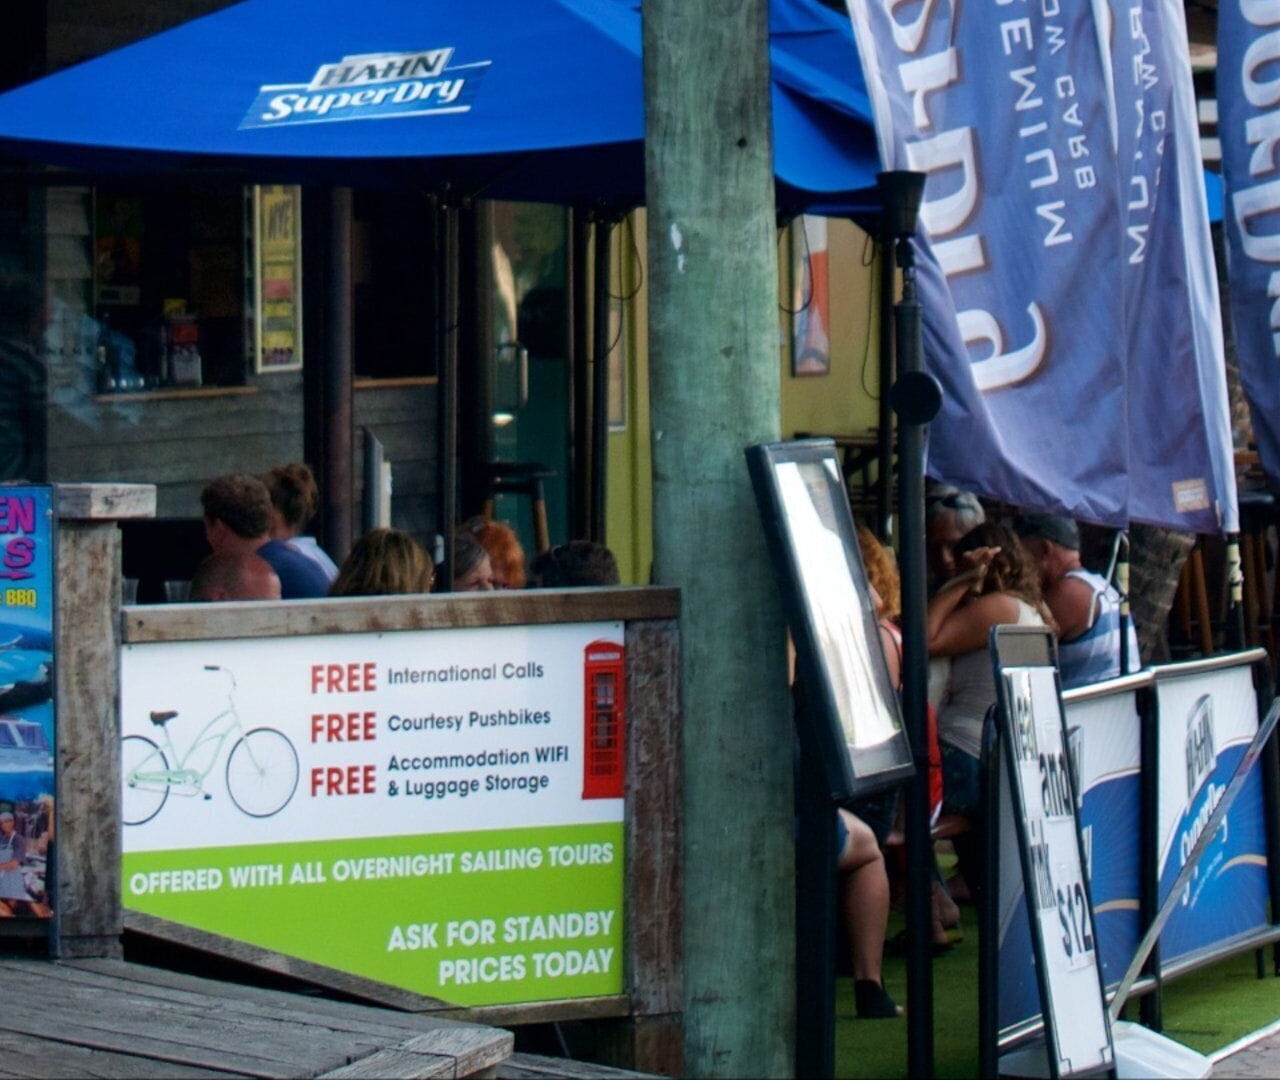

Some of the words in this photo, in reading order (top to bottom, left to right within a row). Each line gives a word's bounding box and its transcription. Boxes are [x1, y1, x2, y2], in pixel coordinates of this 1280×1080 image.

[320, 53, 443, 87] HAHN
[261, 77, 465, 121] SuperDry
[5, 589, 38, 608] BBQ
[311, 662, 377, 694] FREE
[388, 664, 497, 685] International
[502, 662, 544, 680] Calls
[311, 712, 377, 743] FREE
[388, 714, 463, 733] Courtesy
[468, 709, 552, 728] Pushbikes
[388, 748, 530, 771] Accommodation
[535, 746, 569, 763] WIFI
[311, 765, 377, 797] FREE
[388, 781, 399, 796] &
[406, 779, 480, 800] Luggage
[486, 774, 550, 792] Storage
[1038, 752, 1076, 818] and
[130, 870, 222, 896] OFFERED
[228, 864, 283, 890] WITH
[289, 861, 326, 885] ALL
[333, 852, 455, 882] OVERNIGHT
[460, 846, 544, 873] SAILING
[549, 843, 615, 867] TOURS
[387, 924, 438, 953] ASK
[446, 919, 496, 947] FOR
[502, 910, 616, 942] STANDBY
[1057, 882, 1095, 961] $12
[438, 957, 527, 987] PRICES
[532, 948, 615, 978] TODAY
